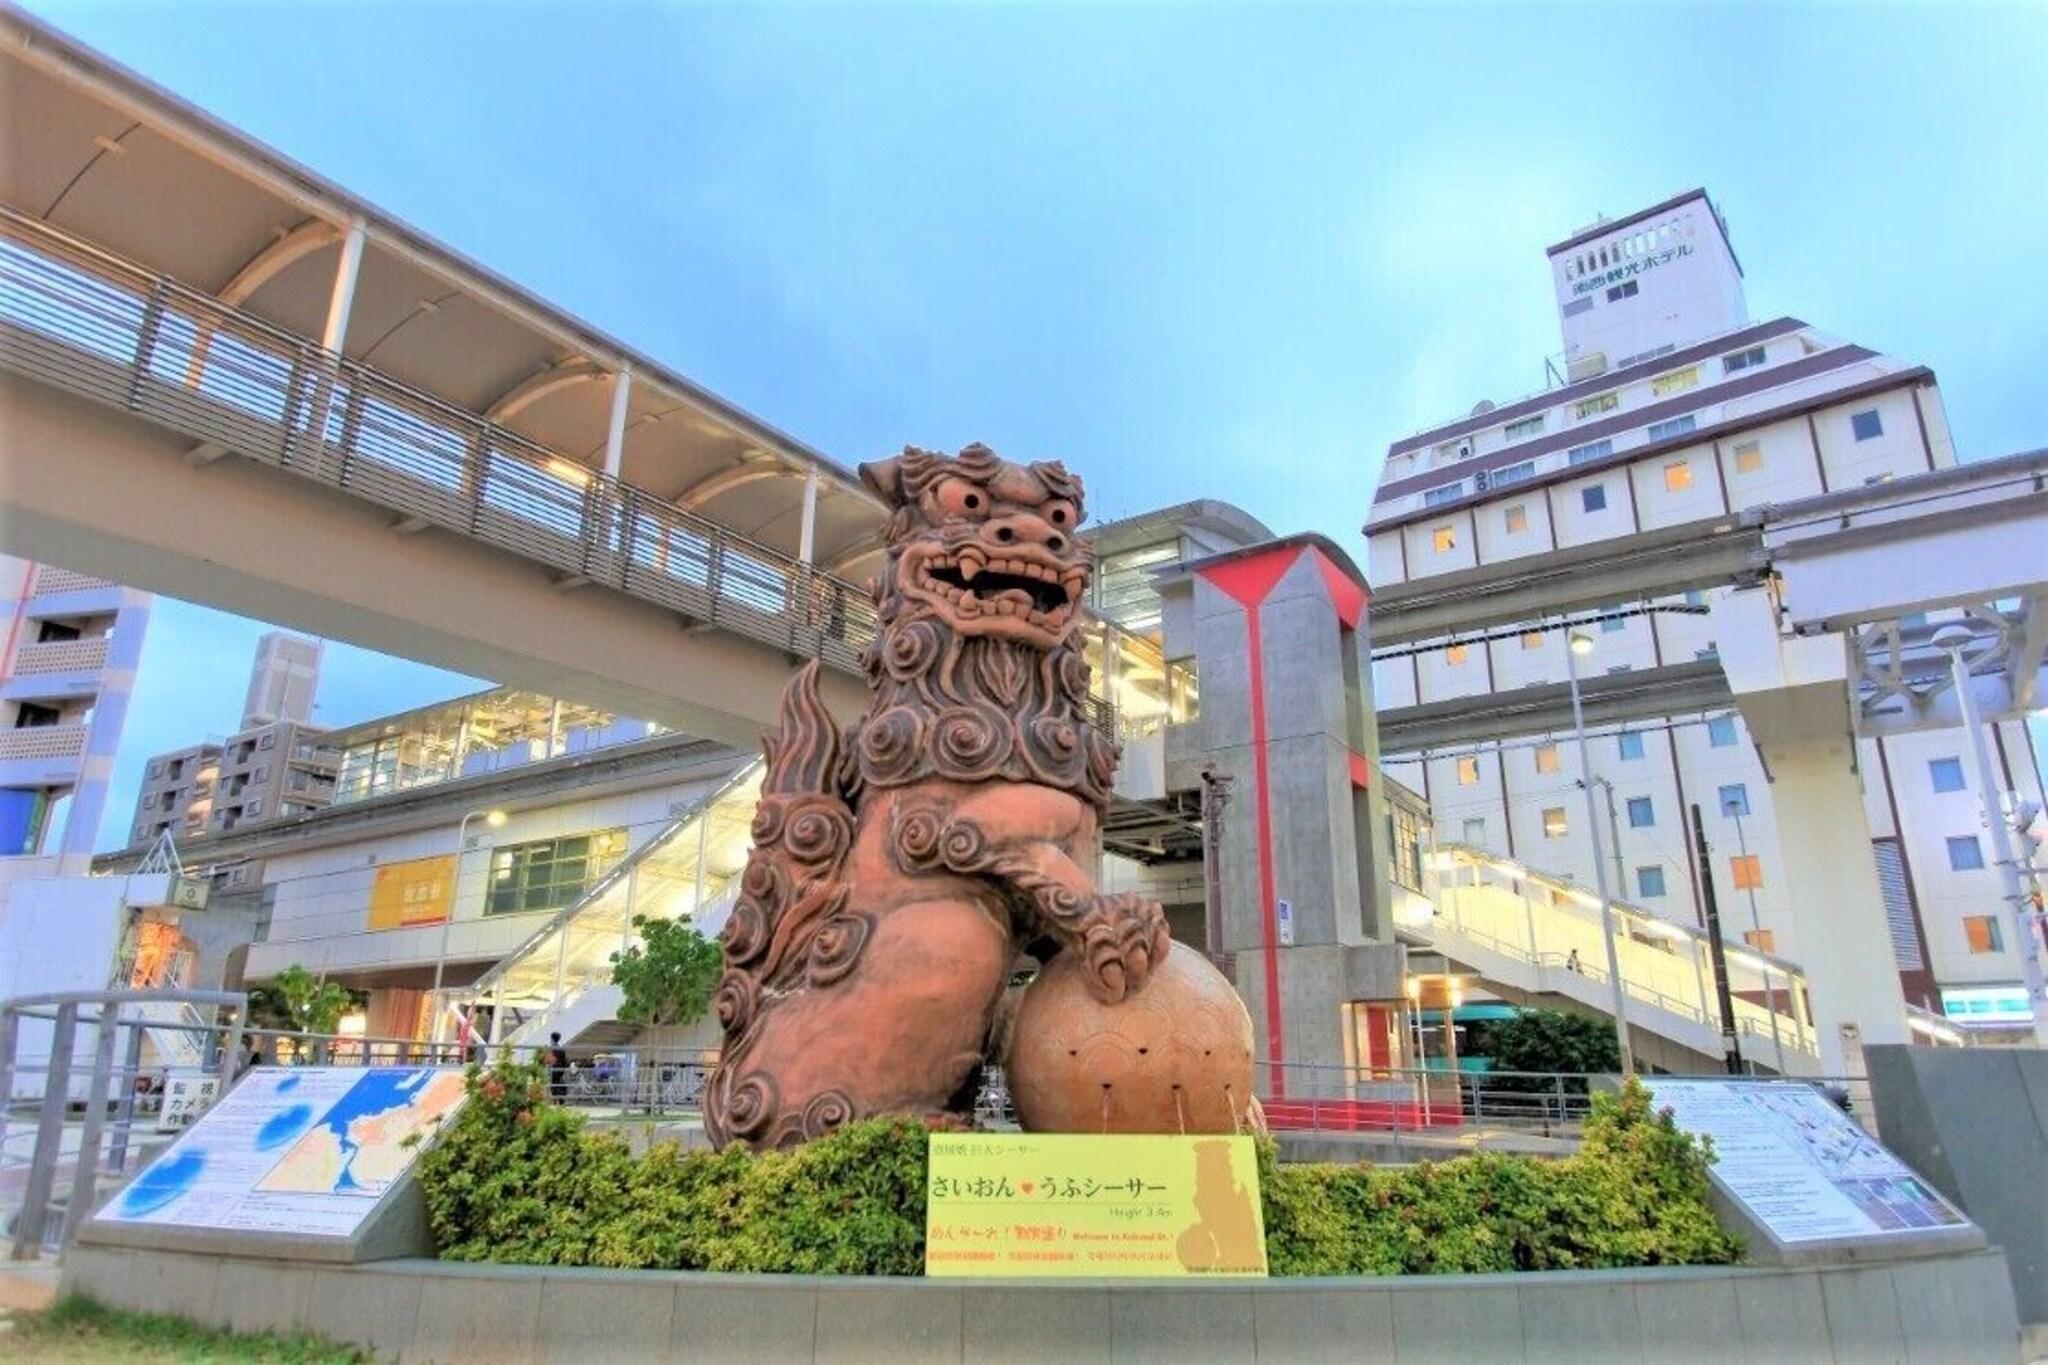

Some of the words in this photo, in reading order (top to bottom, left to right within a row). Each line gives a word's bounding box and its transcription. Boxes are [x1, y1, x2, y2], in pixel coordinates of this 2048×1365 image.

[932, 1176, 1015, 1199] さいおん
[1039, 1176, 1167, 1199] うふシーサー
